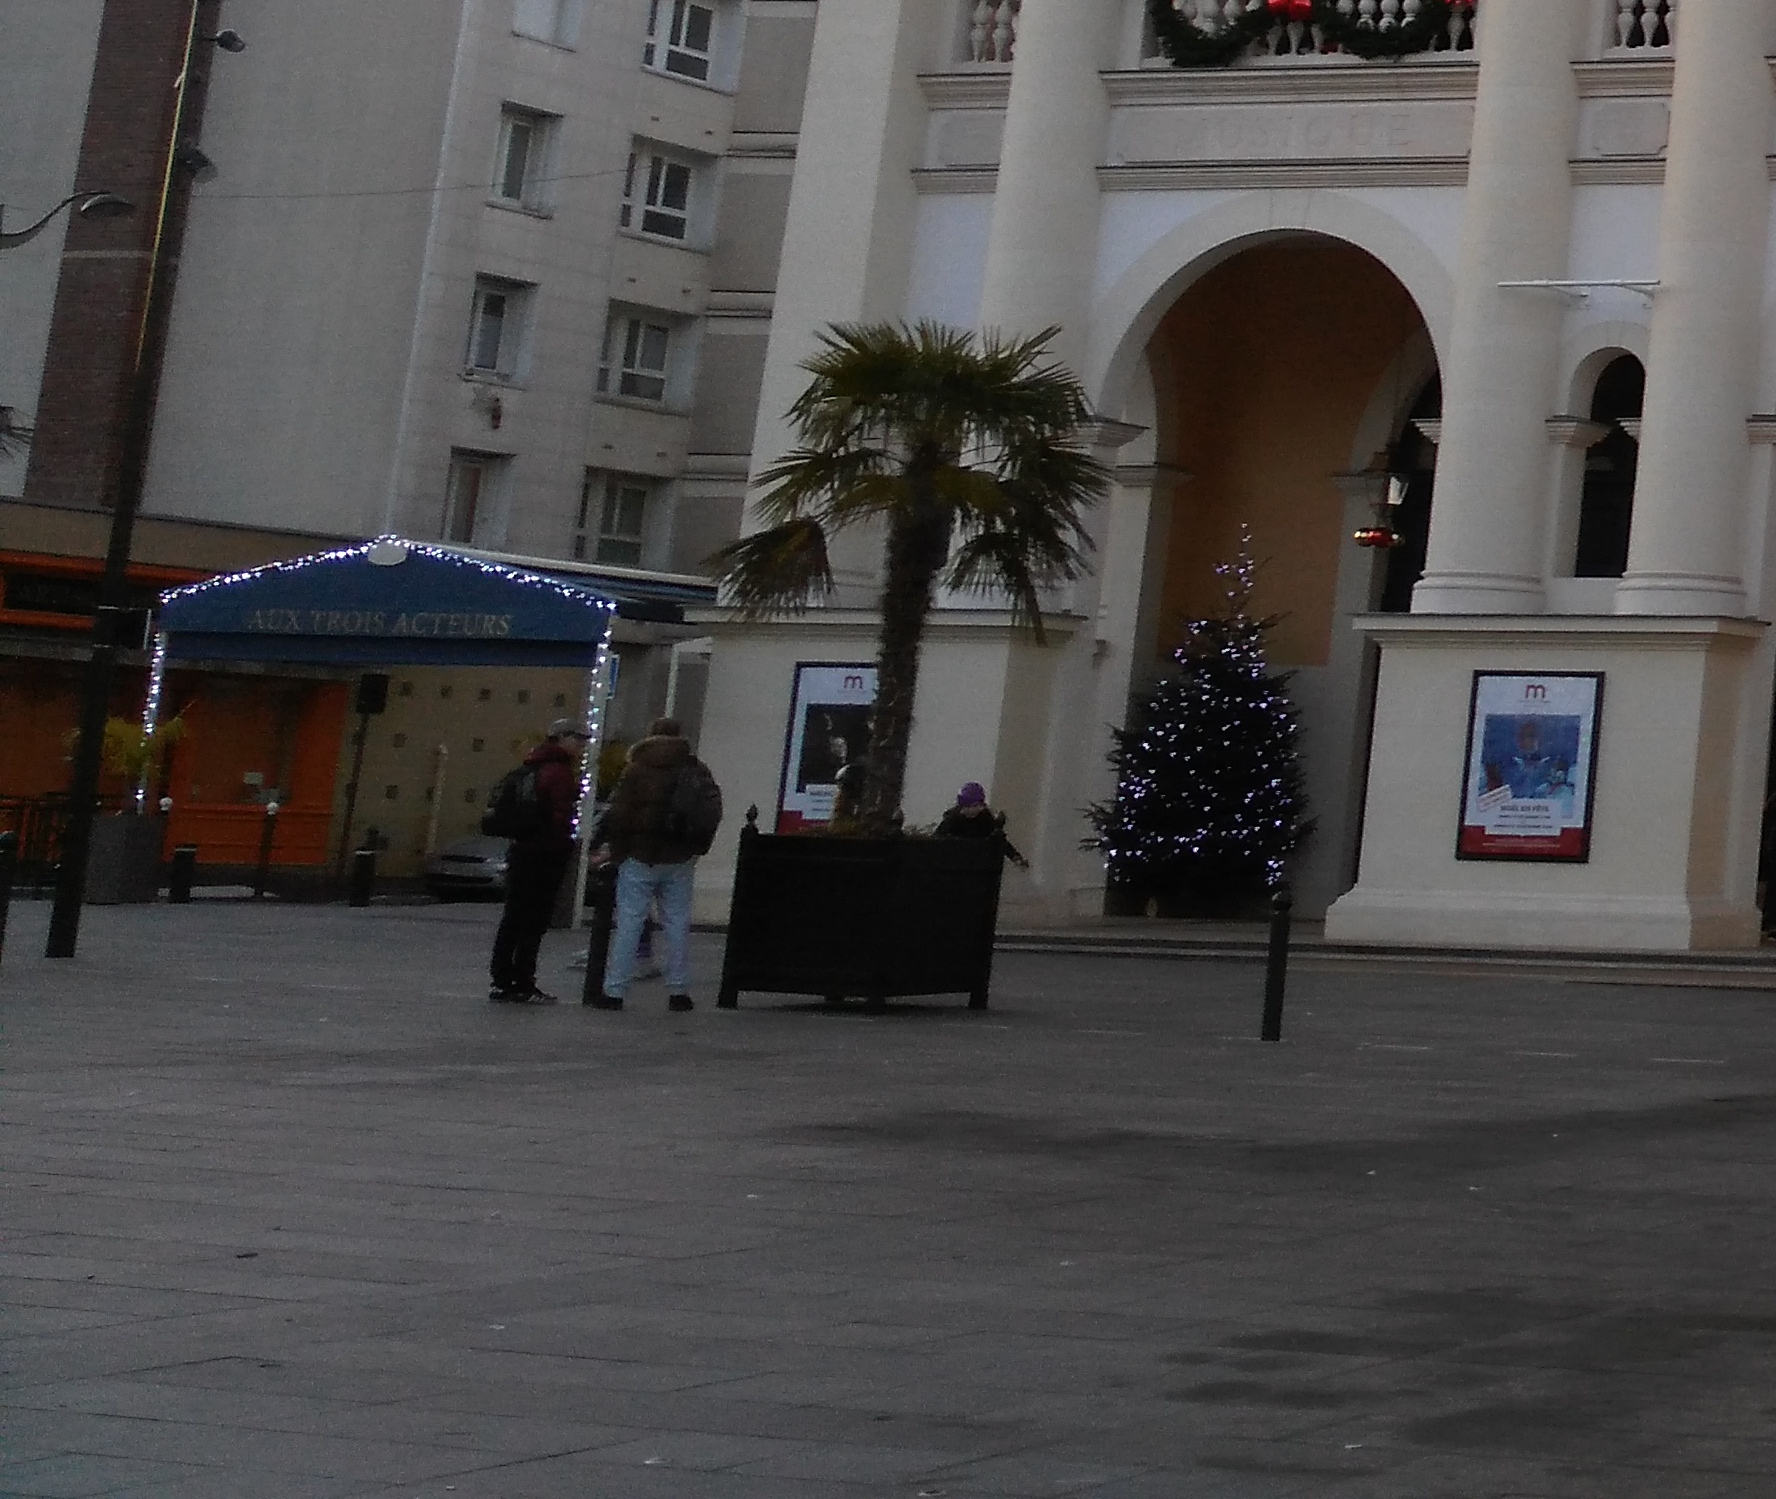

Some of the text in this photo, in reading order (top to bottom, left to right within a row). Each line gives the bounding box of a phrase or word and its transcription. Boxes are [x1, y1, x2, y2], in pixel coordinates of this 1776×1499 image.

[249, 609, 514, 636] AUX TROIS ACTEURS
